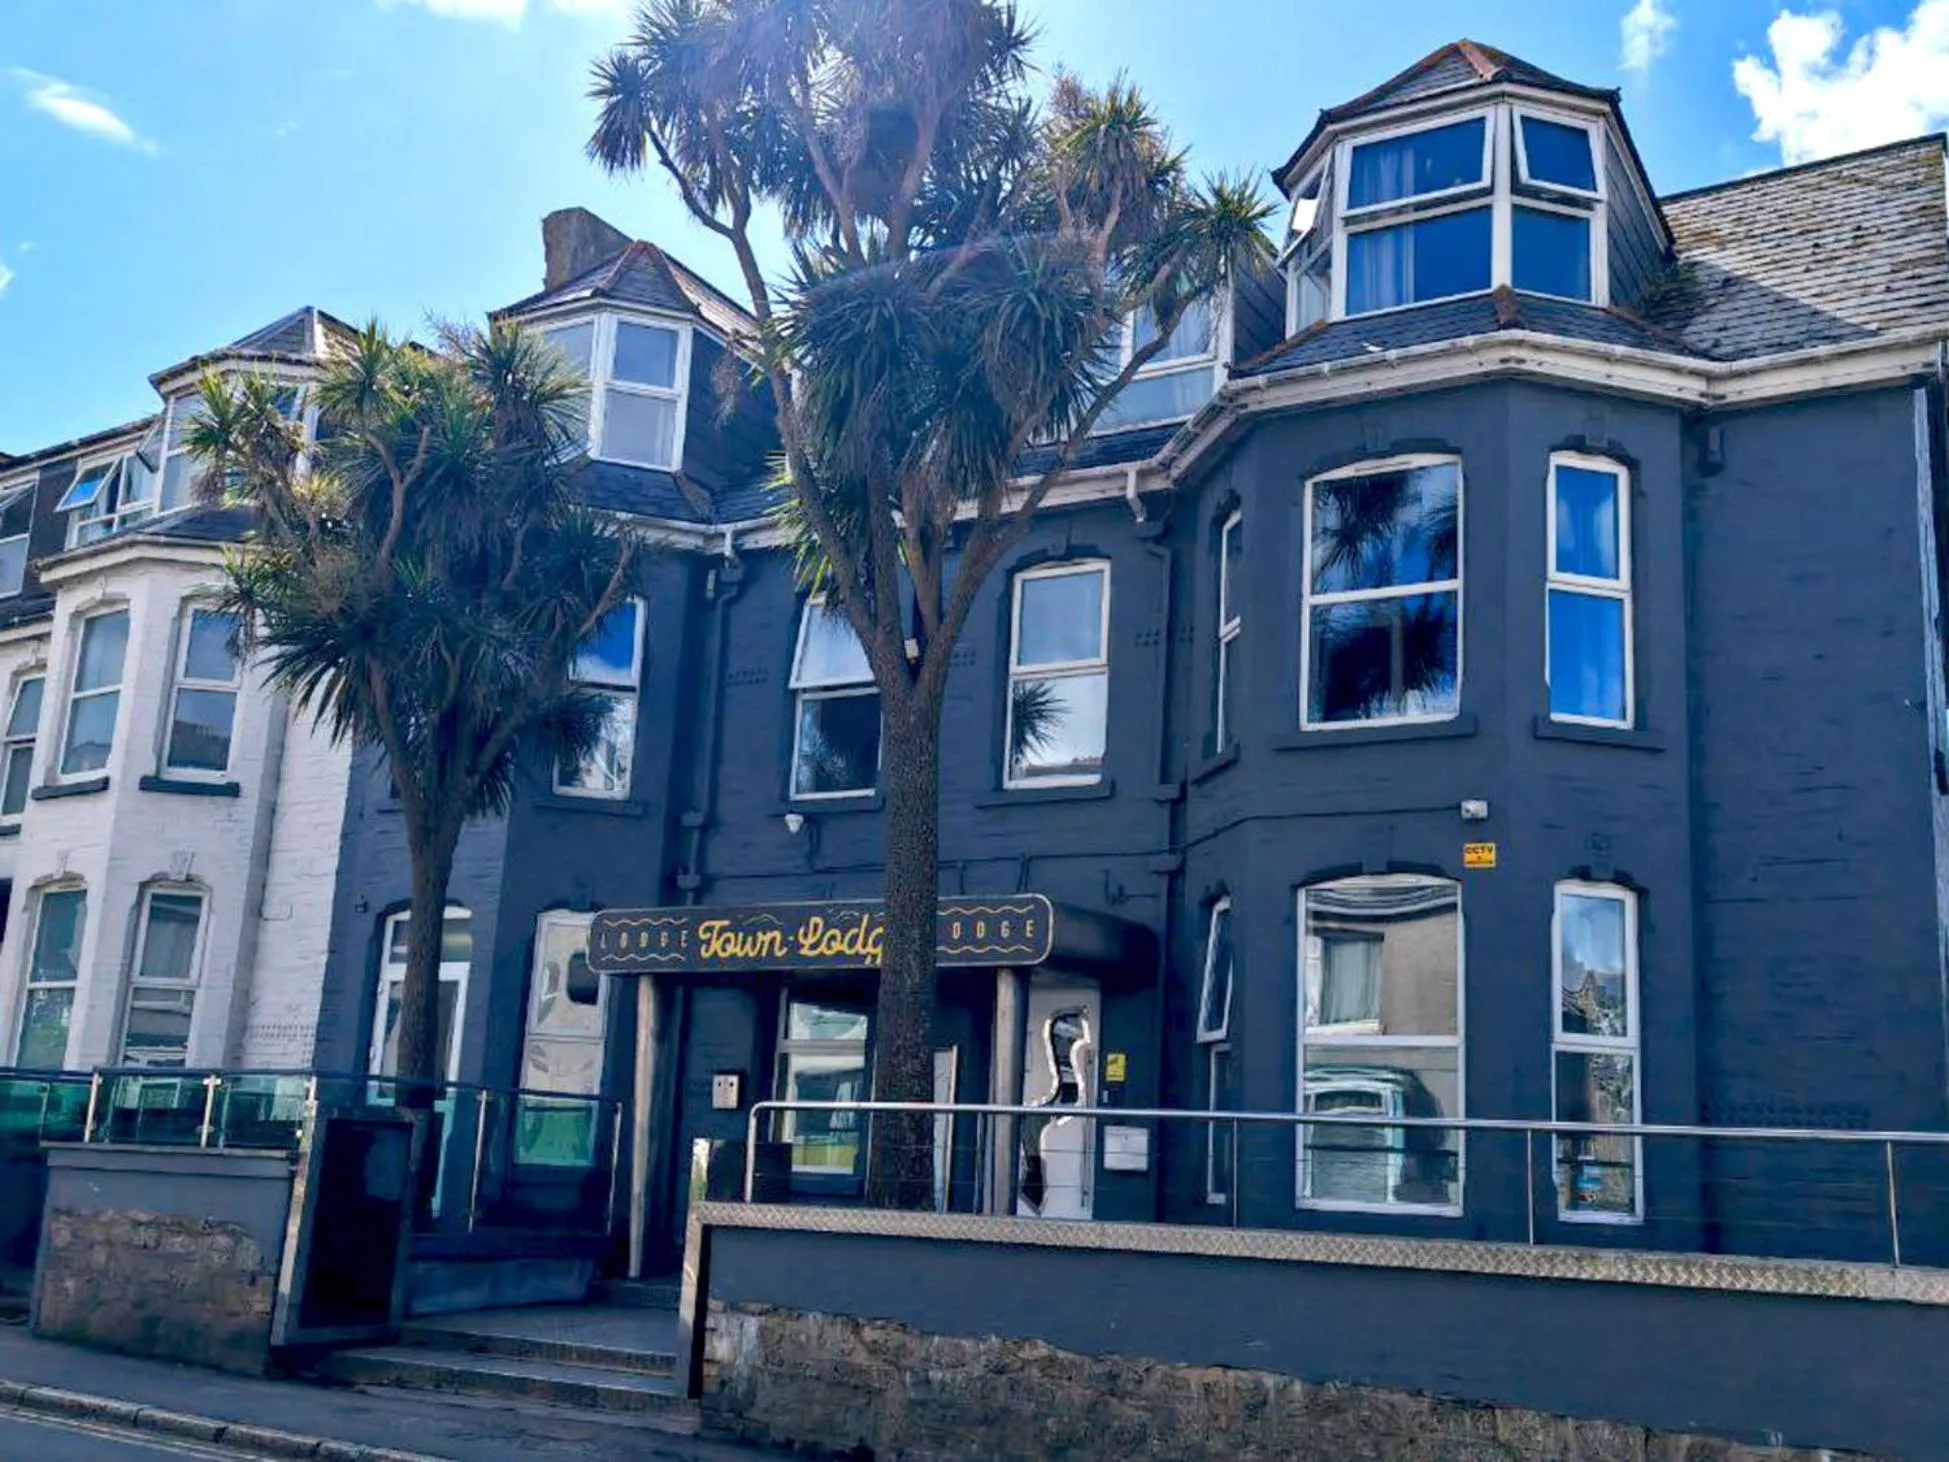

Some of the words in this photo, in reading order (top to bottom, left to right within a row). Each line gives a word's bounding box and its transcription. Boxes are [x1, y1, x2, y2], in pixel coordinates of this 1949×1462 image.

[600, 929, 688, 949] LODGE
[698, 919, 789, 959] Town
[798, 913, 885, 966] Lodg
[952, 919, 1035, 940] ODGE
